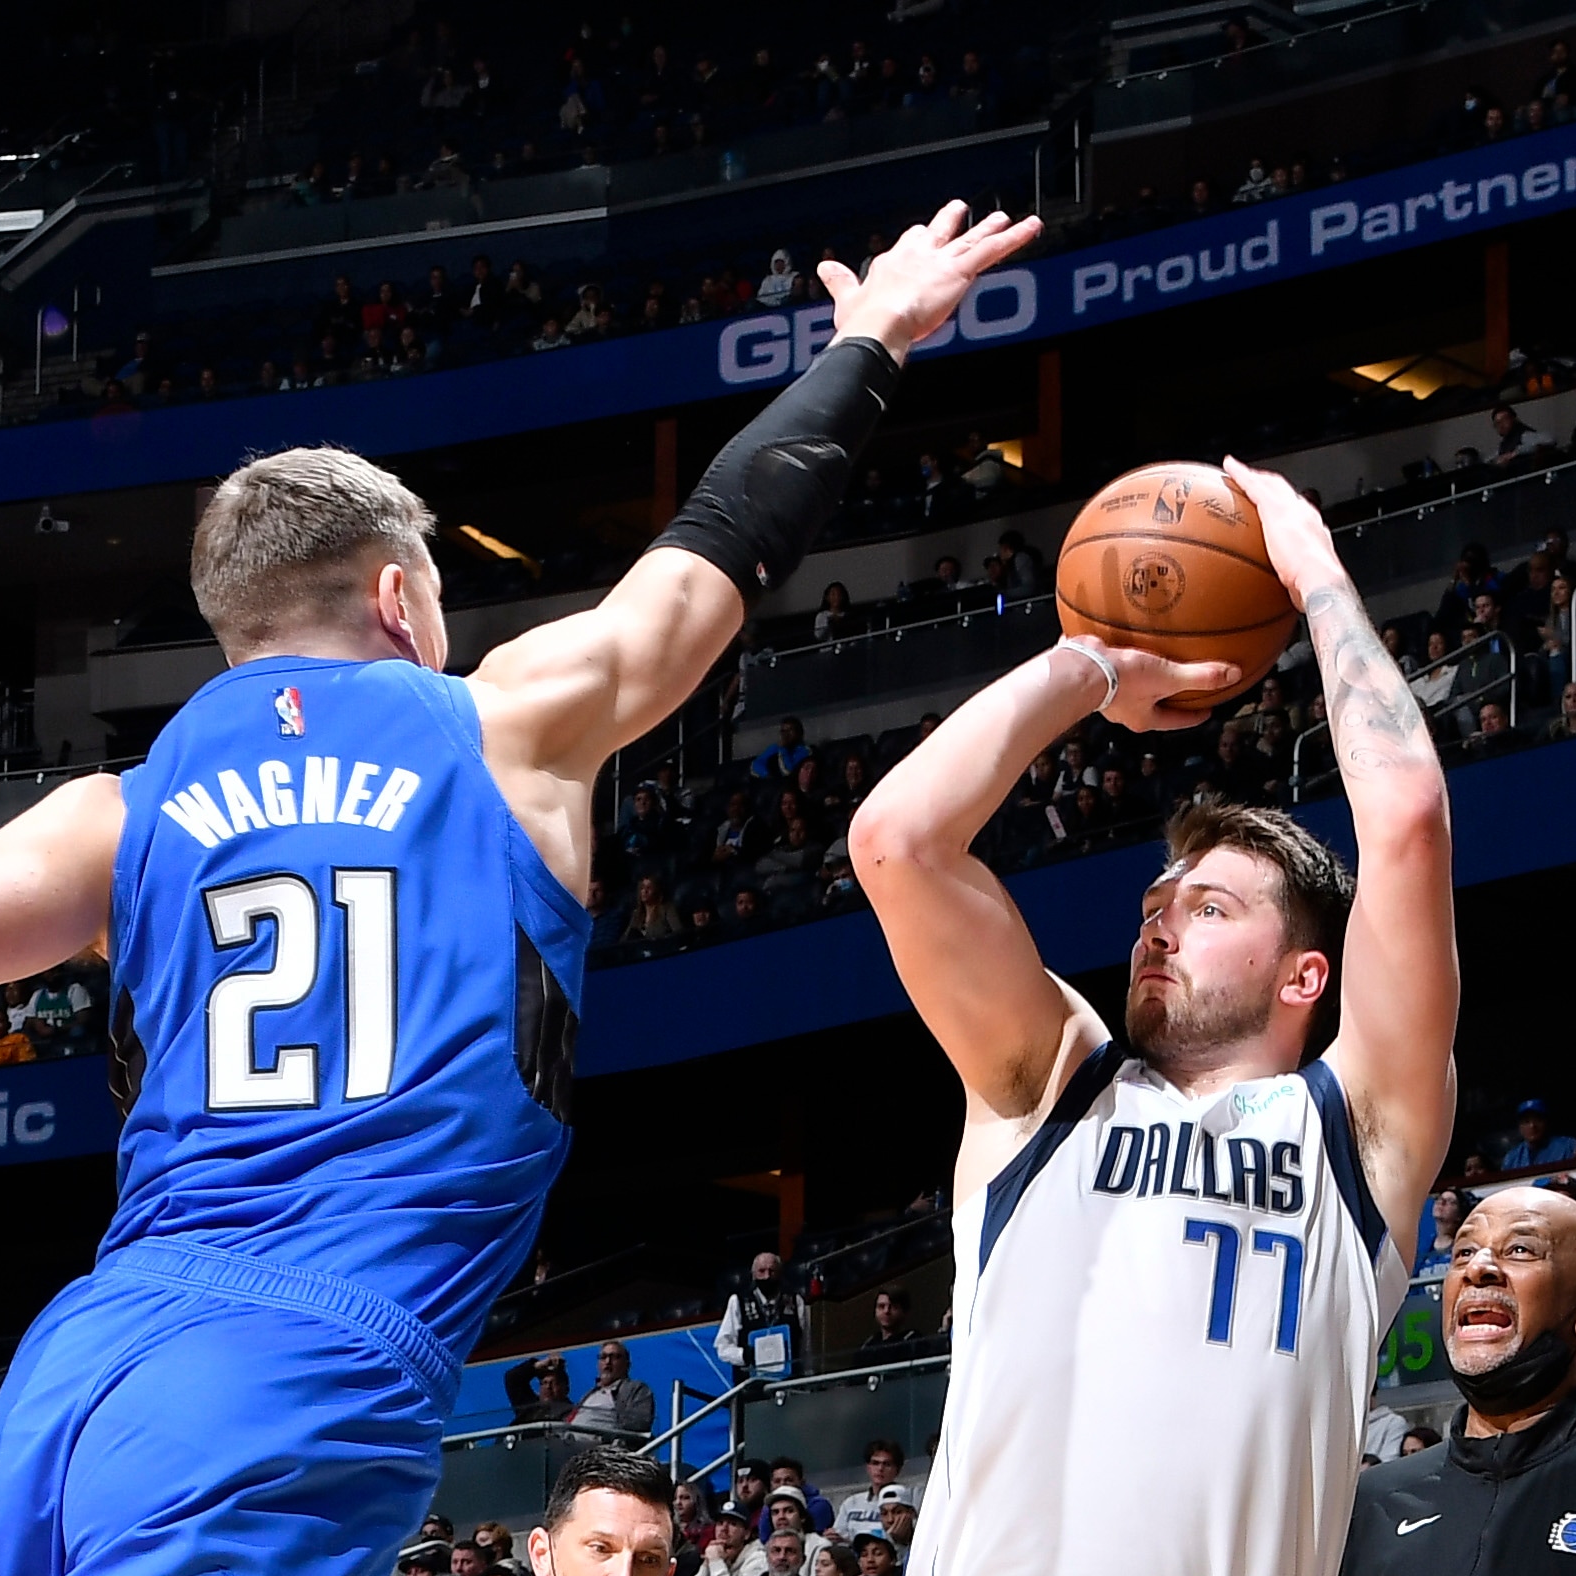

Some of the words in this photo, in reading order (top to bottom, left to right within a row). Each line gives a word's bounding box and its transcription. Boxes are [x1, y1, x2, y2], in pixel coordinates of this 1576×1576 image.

[718, 268, 1037, 384] GEO
[1072, 218, 1281, 314] Proud
[160, 755, 421, 849] WAGNER
[203, 865, 400, 1114] 21
[1088, 1119, 1307, 1219] DALLAS
[1183, 1215, 1310, 1358] 77
